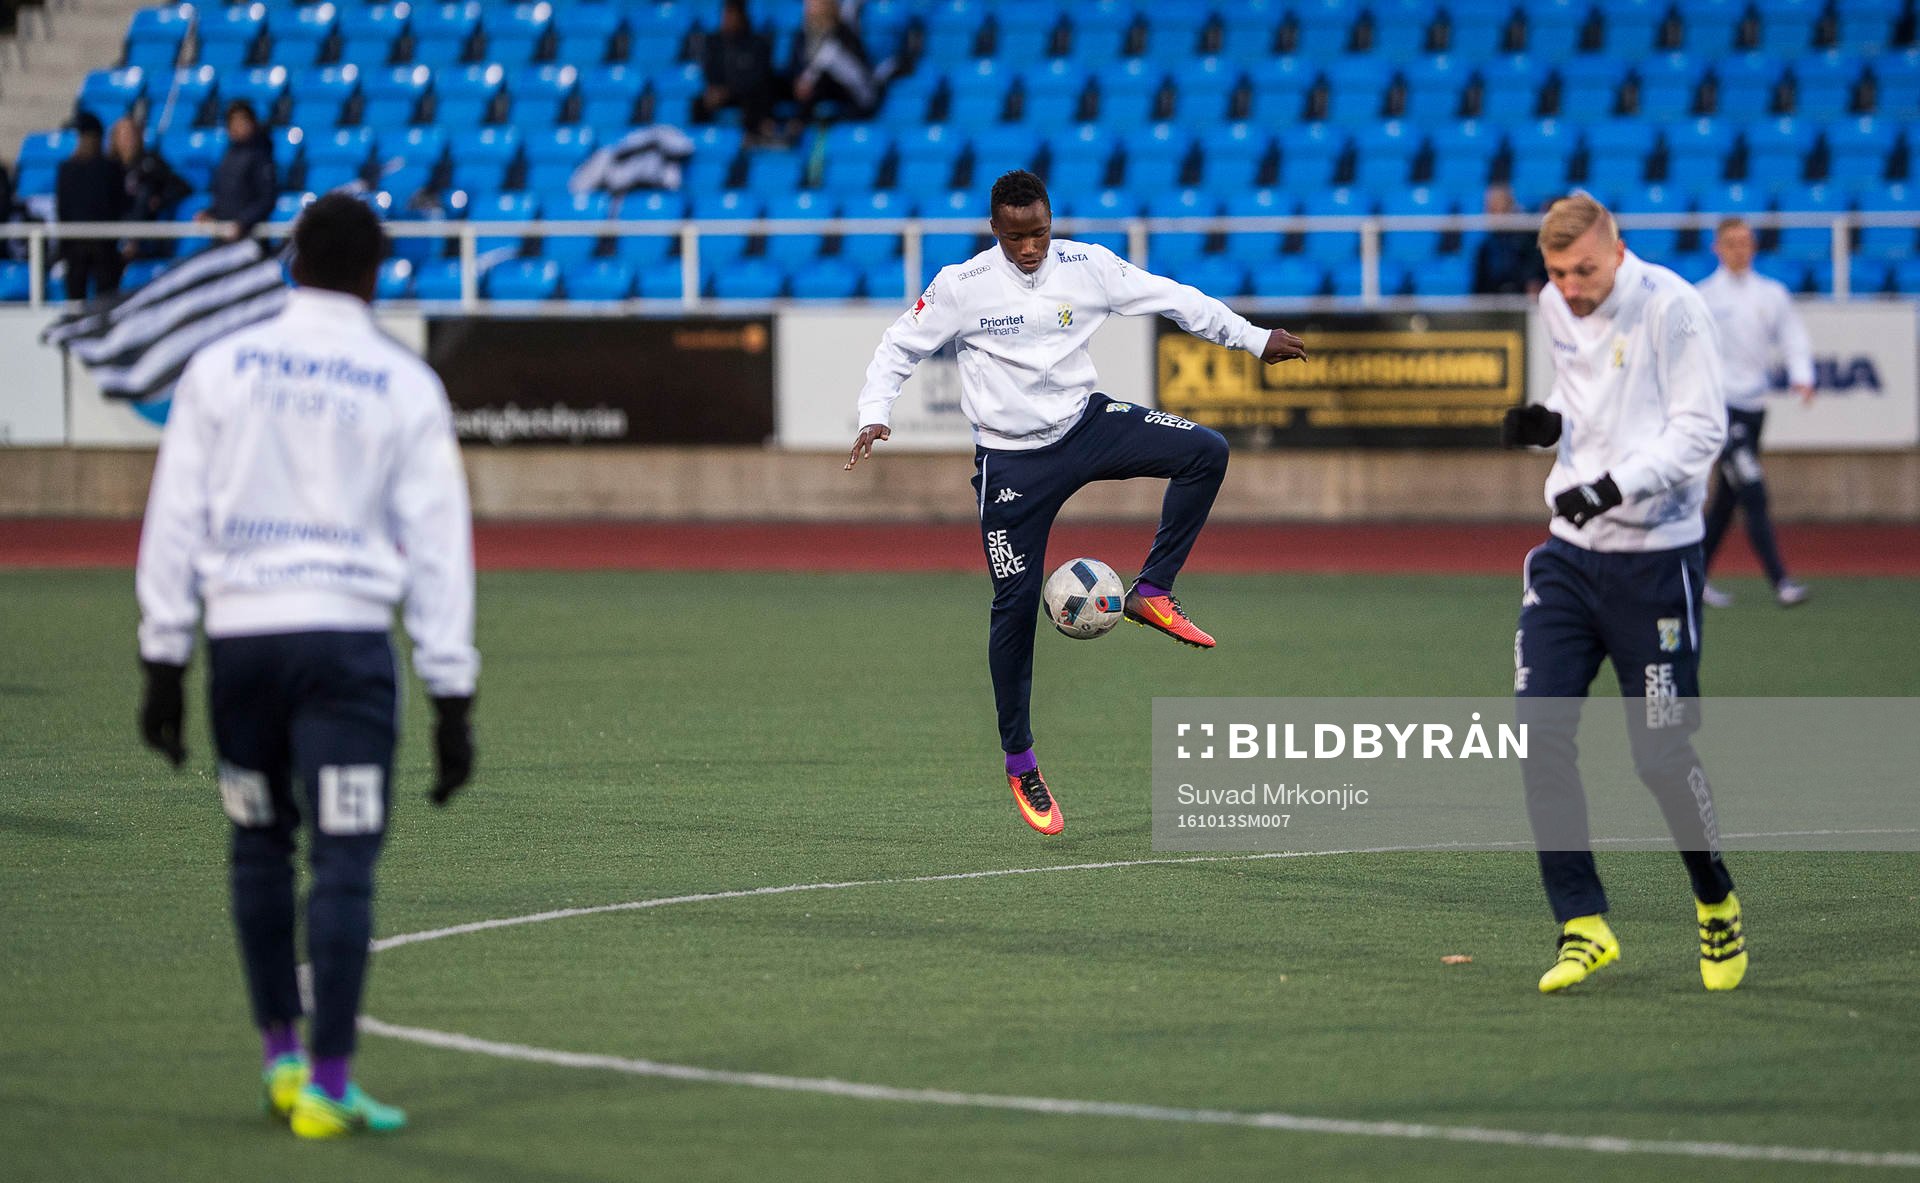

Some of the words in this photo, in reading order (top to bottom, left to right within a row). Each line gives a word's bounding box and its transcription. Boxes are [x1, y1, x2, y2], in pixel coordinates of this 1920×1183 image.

[1060, 253, 1088, 264] RASTA
[958, 264, 991, 281] Kappa
[980, 314, 1025, 329] Prioritet
[987, 326, 1020, 336] Finans
